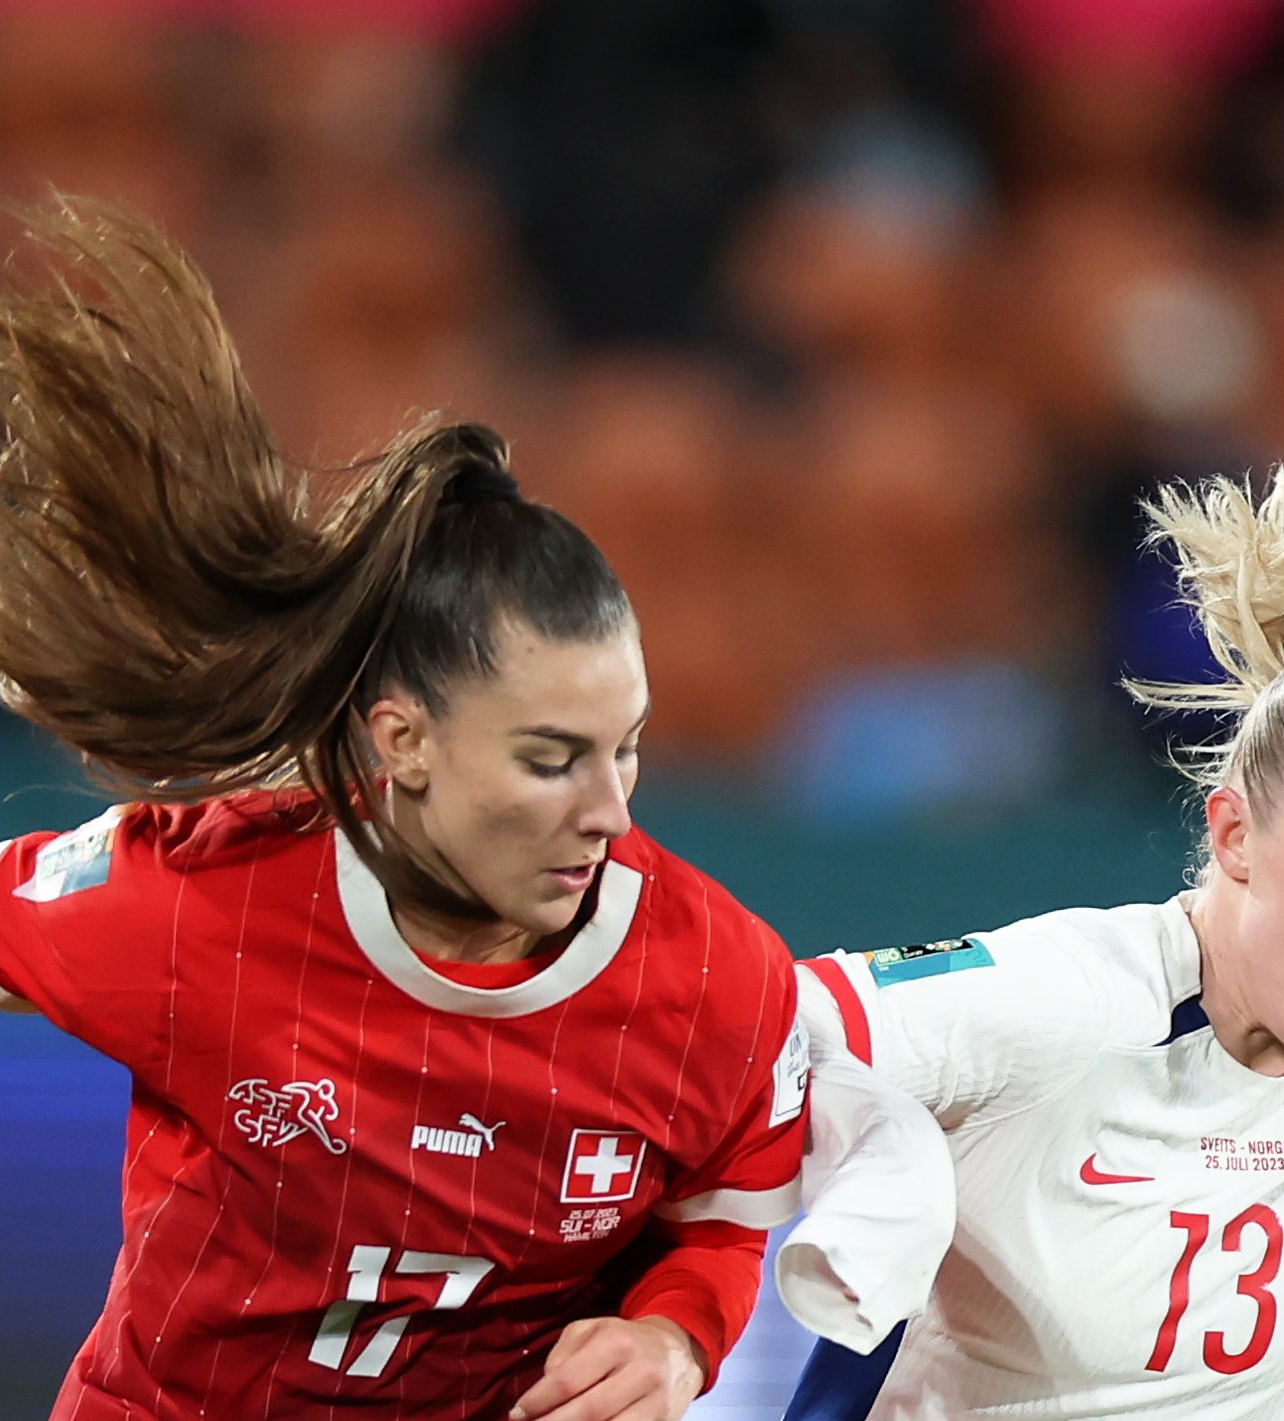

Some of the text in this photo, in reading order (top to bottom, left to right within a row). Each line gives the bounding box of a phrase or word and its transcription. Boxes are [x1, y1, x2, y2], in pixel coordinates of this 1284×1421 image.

[411, 1125, 483, 1158] PUMA
[1200, 1136, 1236, 1154] SVEITS
[1205, 1155, 1284, 1171] 25. JULI 2023
[559, 1219, 583, 1235] SUI
[592, 1216, 621, 1232] NOR
[1145, 1203, 1284, 1375] 13
[308, 1246, 495, 1378] 17
